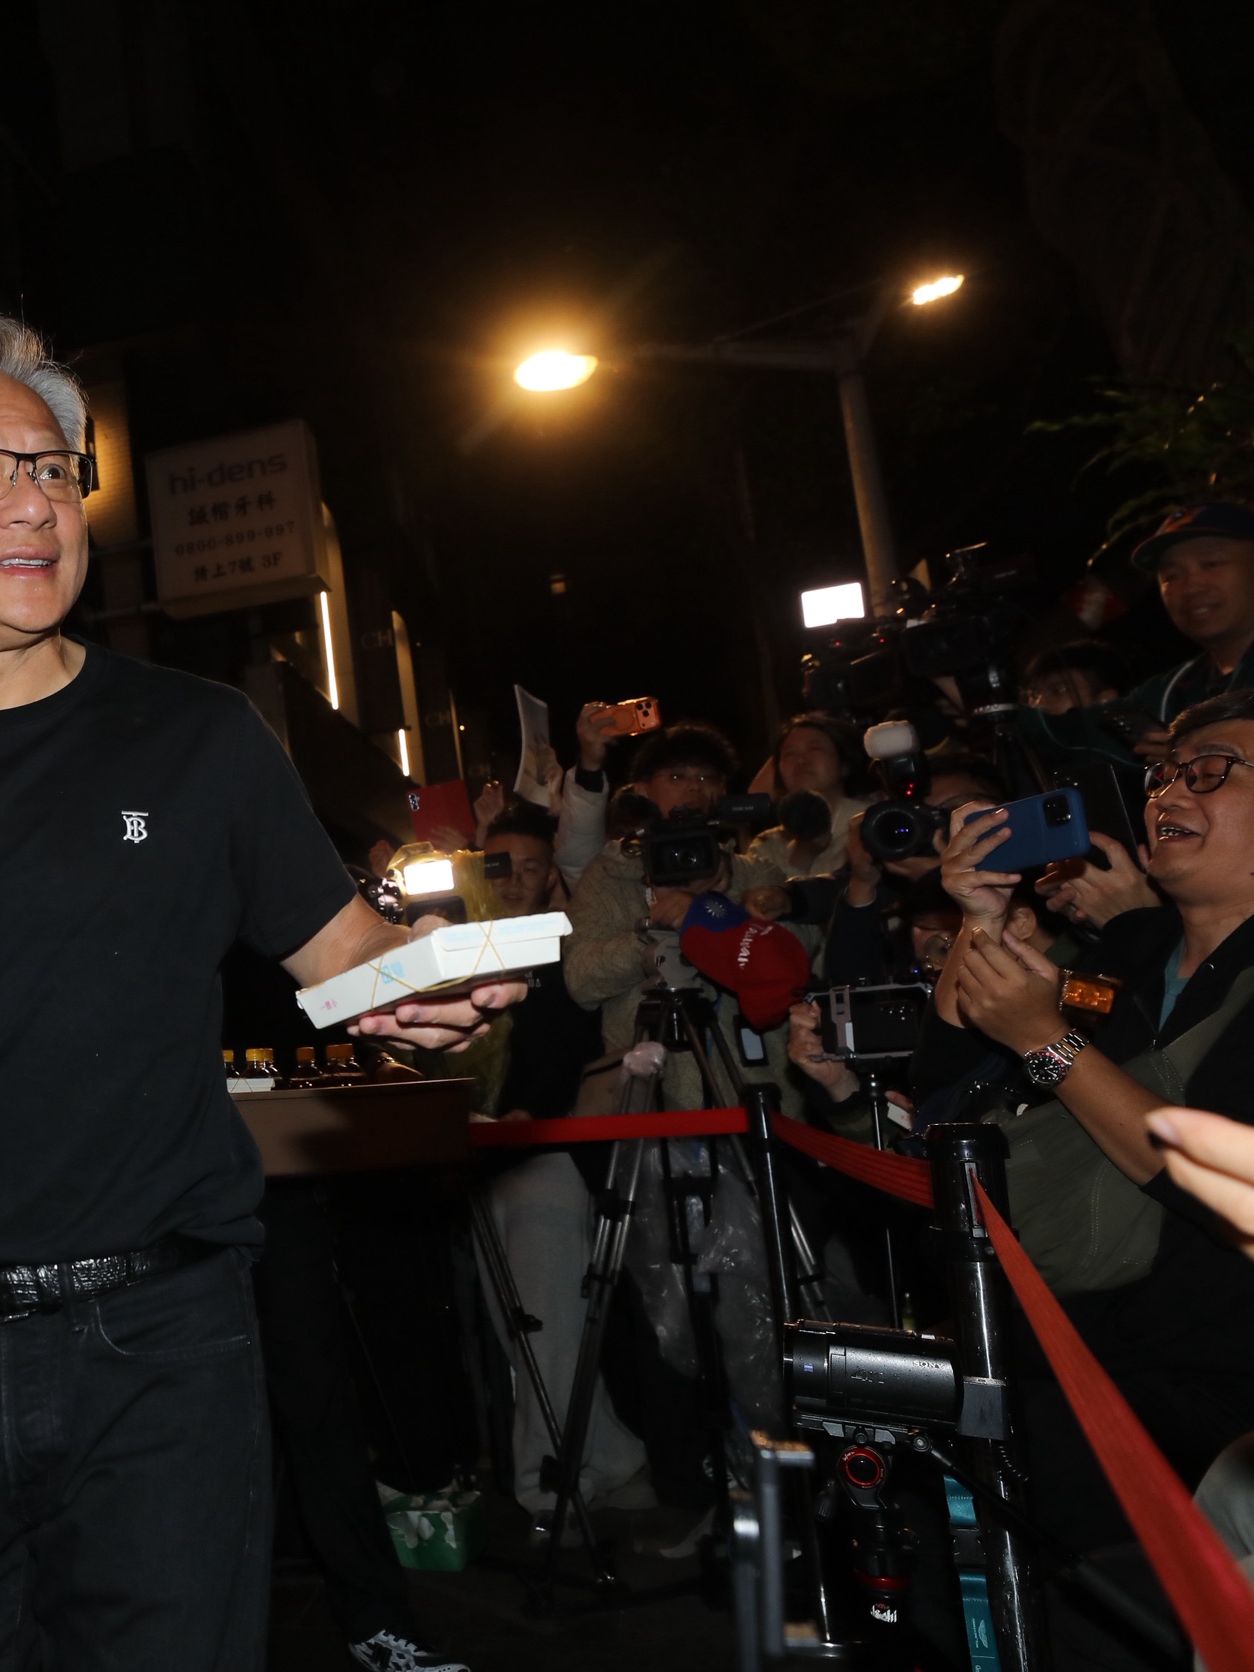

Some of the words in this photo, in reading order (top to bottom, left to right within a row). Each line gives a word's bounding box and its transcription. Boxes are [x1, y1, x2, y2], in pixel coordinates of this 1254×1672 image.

[168, 453, 288, 495] hi-dens
[175, 520, 295, 556] 0800-899-997
[262, 551, 283, 569] 3F
[912, 1359, 946, 1370] SONY
